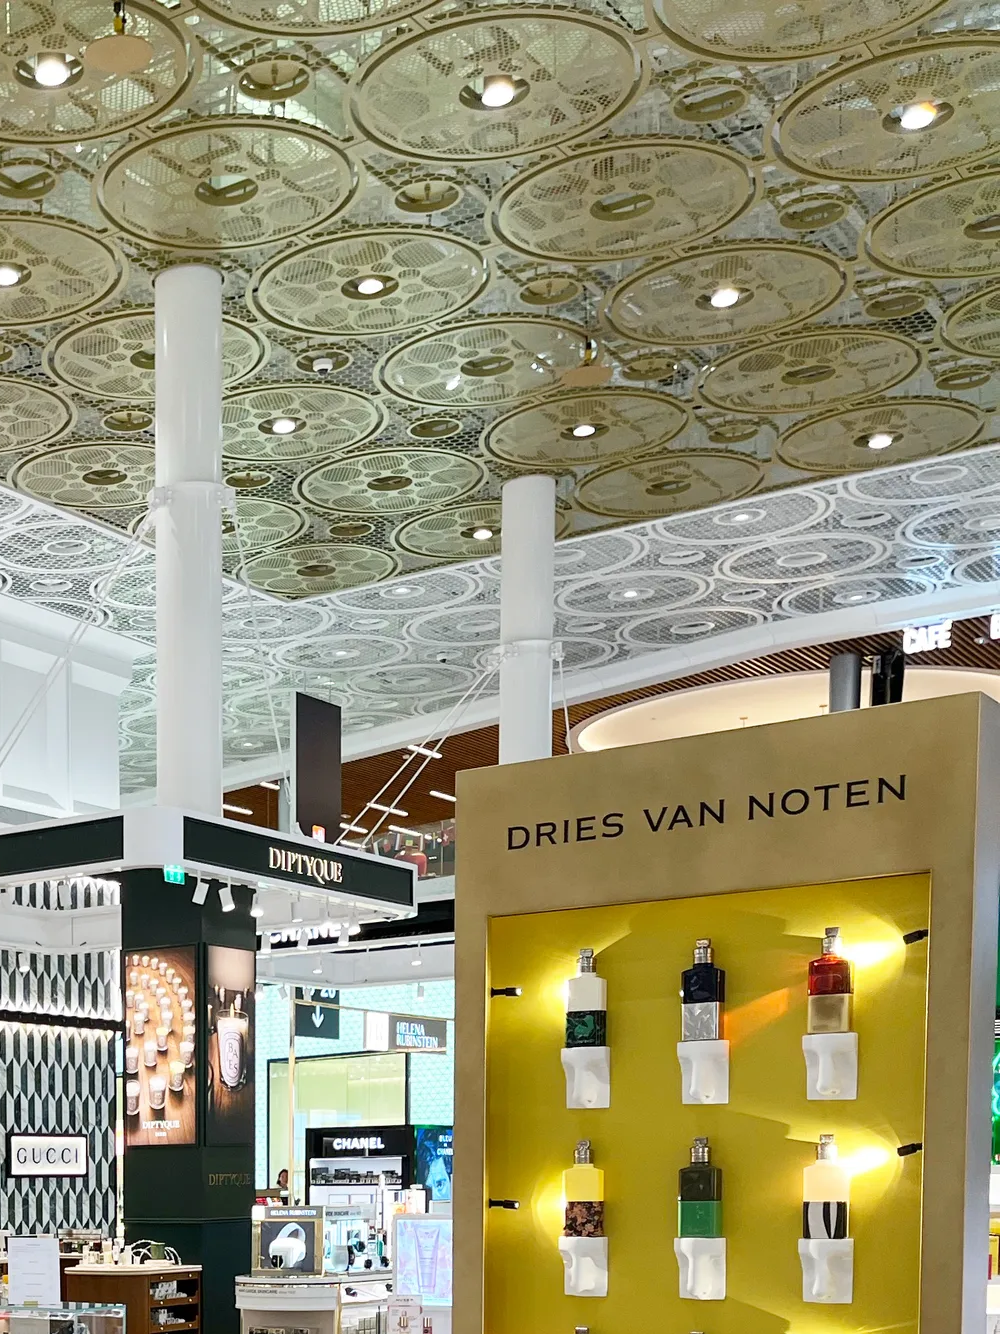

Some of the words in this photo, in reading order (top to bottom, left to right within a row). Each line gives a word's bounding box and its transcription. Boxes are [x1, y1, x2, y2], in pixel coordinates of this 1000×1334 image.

[507, 812, 624, 851] DRIES
[643, 799, 726, 832] VAN
[748, 774, 907, 821] NOTEN
[268, 846, 343, 885] DIPTYQUE
[396, 1021, 426, 1036] HELENA
[396, 1034, 439, 1049] RUBINSTEIN
[142, 1120, 181, 1130] DIPTYQUE
[332, 1136, 385, 1150] CHANEL
[16, 1147, 79, 1165] GUCCI
[208, 1173, 251, 1187] DIPTYQUE
